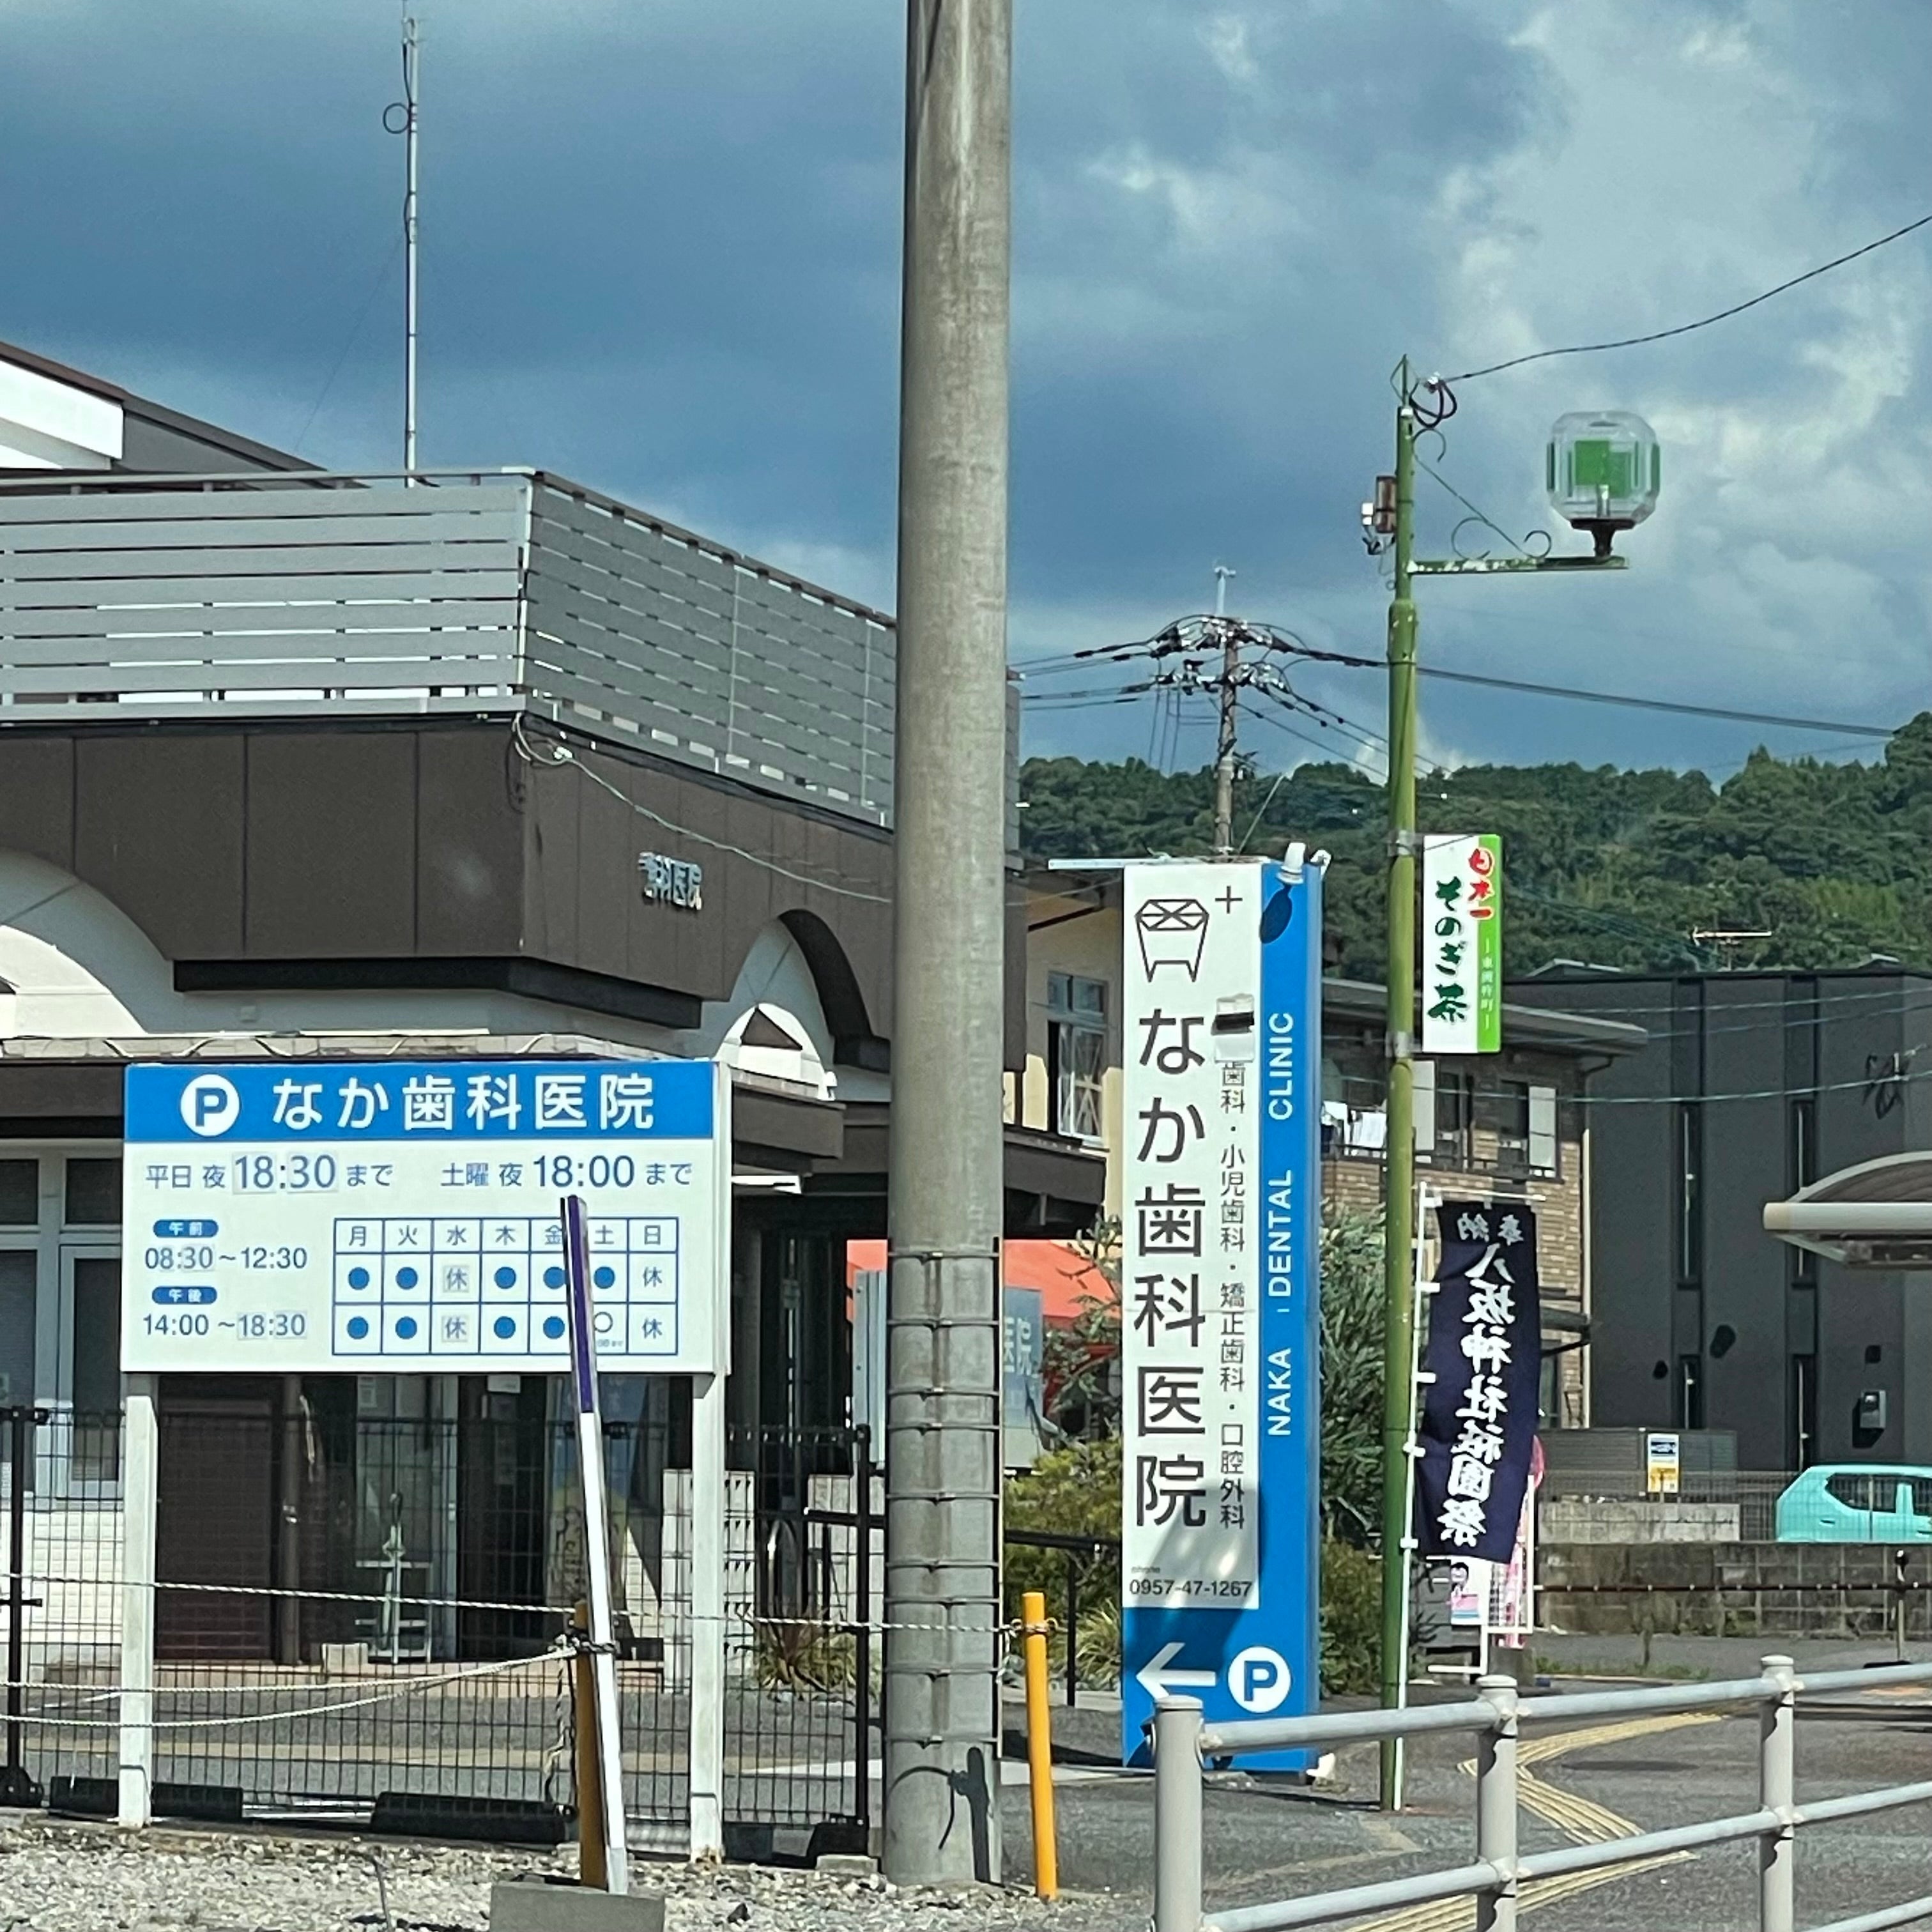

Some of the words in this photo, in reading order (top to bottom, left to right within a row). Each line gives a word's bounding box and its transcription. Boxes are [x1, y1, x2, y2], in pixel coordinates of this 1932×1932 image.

[1427, 876, 1468, 1023] そのぎ茶
[1268, 1013, 1293, 1120] CLINIC
[273, 1073, 654, 1131] なか歯科医院
[235, 1154, 335, 1189] 18:30
[533, 1155, 634, 1188] 18:00
[349, 1225, 367, 1247] 月
[397, 1225, 418, 1246] 火
[446, 1225, 467, 1246] 水
[495, 1225, 516, 1246] 木
[594, 1225, 615, 1245] 土
[645, 1225, 661, 1245] 日
[1268, 1170, 1291, 1296] DENTAL
[447, 1268, 467, 1291] 休
[643, 1266, 663, 1287] 休
[1134, 1009, 1206, 1527] なか歯科医院
[445, 1317, 467, 1339] 休
[642, 1317, 663, 1339] 休
[1268, 1349, 1291, 1436] NAKA
[1130, 1579, 1253, 1597] 0957-47-1267
